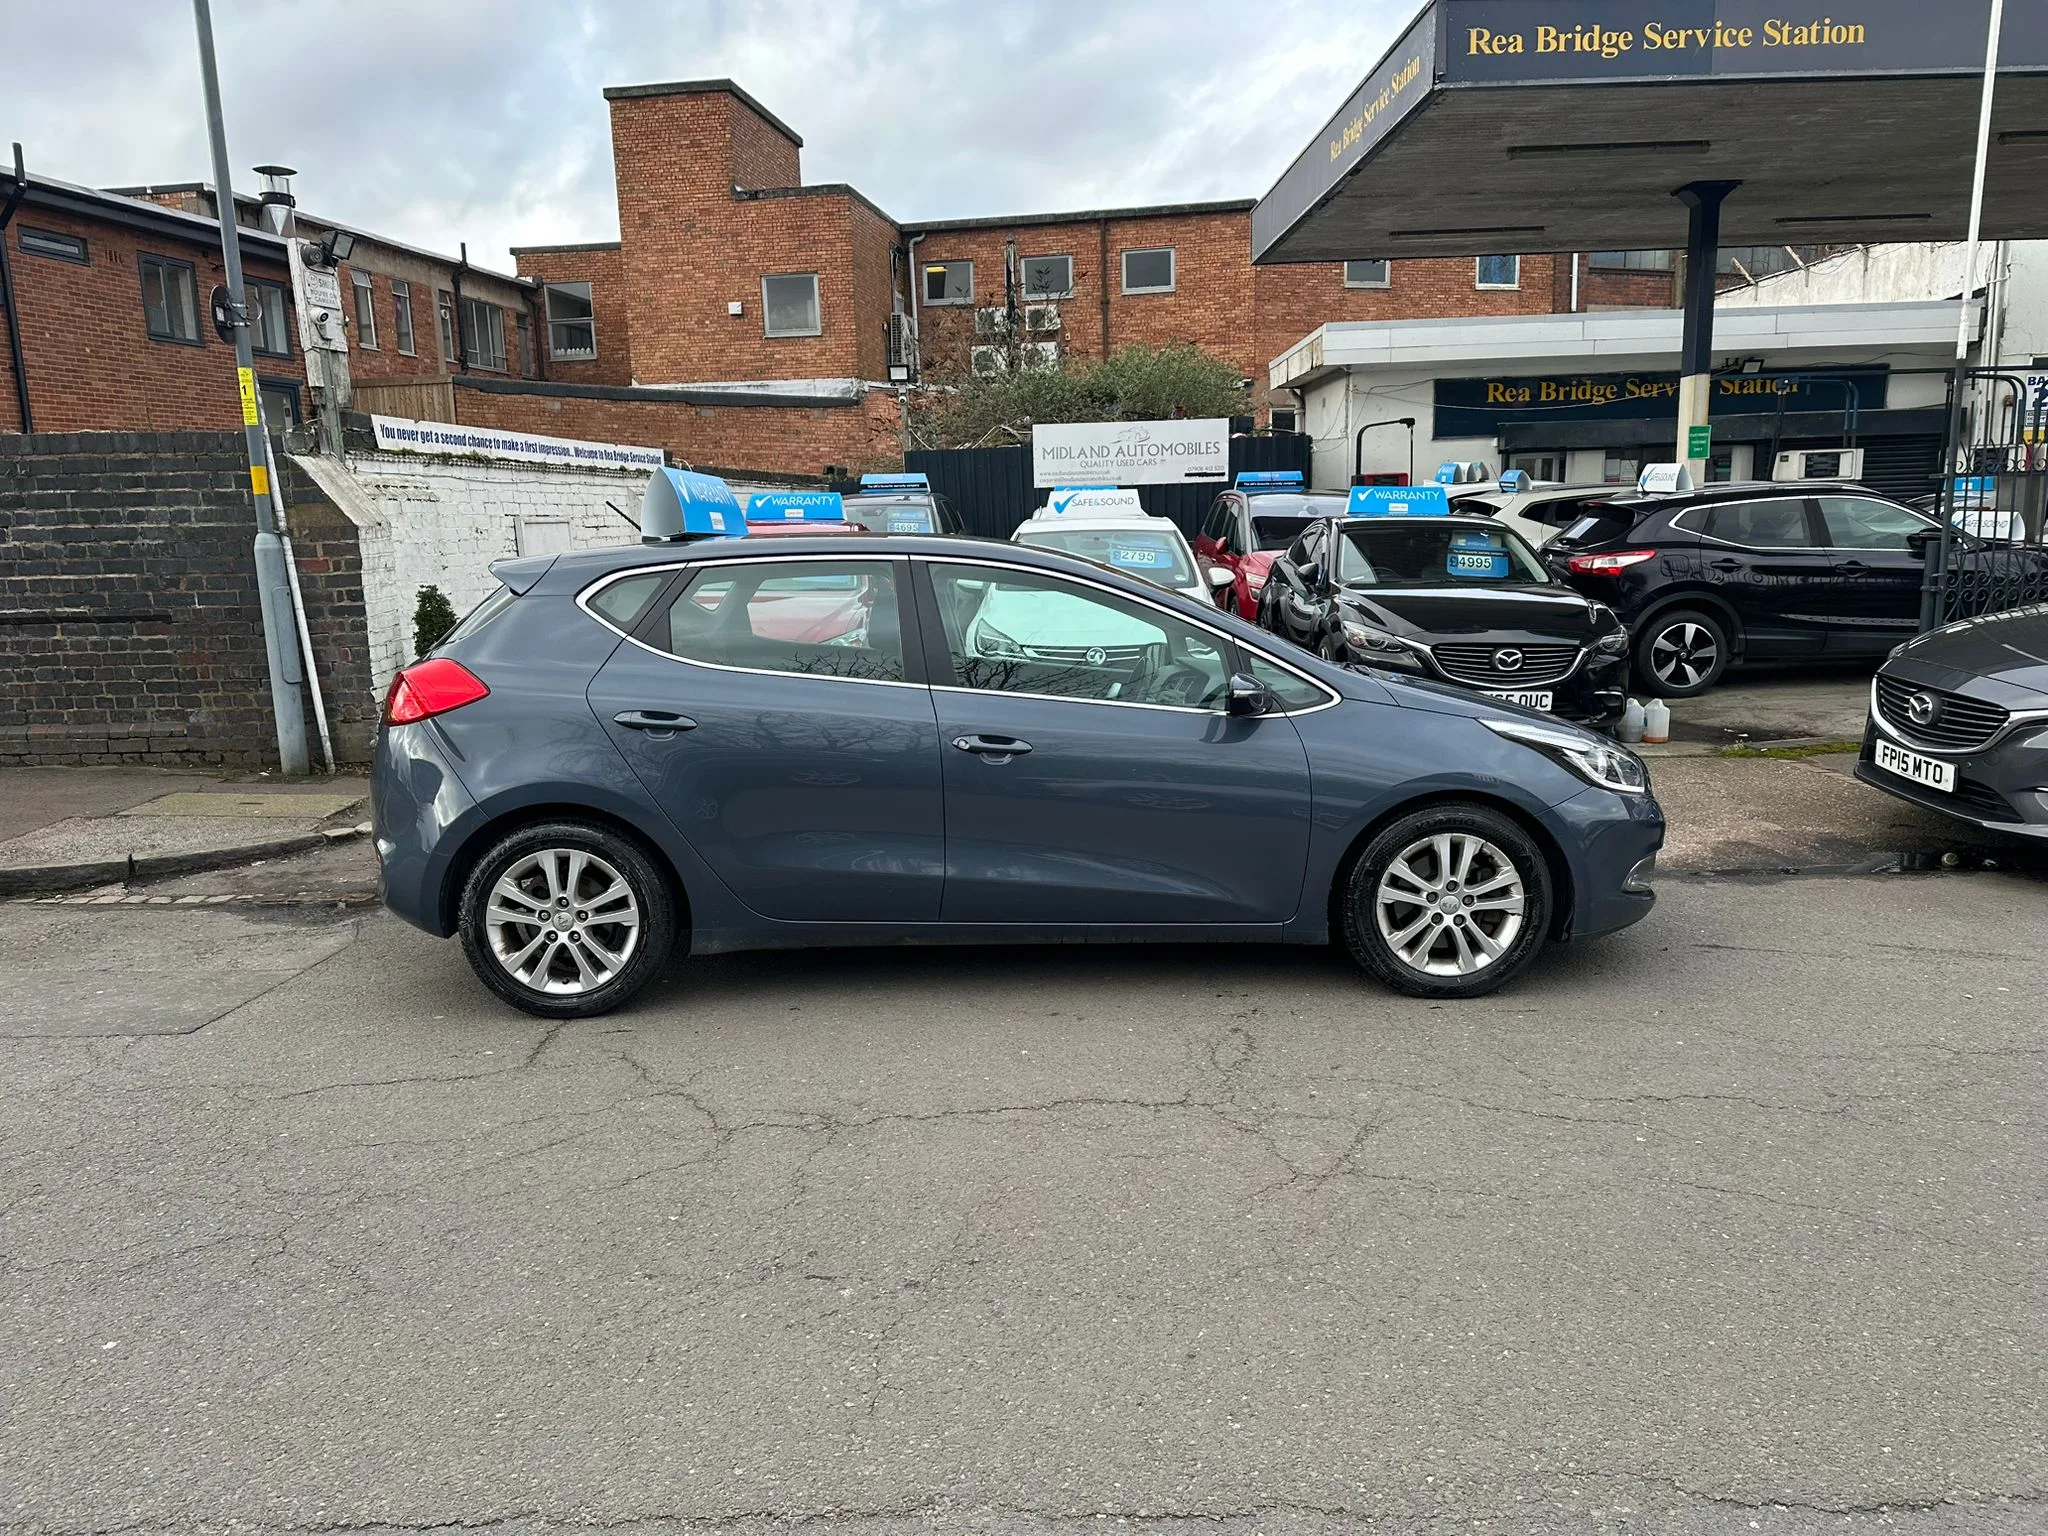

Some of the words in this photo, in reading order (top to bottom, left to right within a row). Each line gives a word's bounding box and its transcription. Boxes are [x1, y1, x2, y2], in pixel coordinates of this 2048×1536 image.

[1466, 27, 1524, 56] Rea
[1534, 24, 1634, 59] Bridge
[1642, 20, 1753, 51] Service
[1762, 16, 1865, 47] Station
[1330, 140, 1341, 162] Rea
[1343, 116, 1363, 150] Bridge
[1363, 87, 1390, 127] Service
[1391, 55, 1420, 99] Station
[241, 384, 247, 395] 1
[1486, 382, 1531, 403] Rea
[1539, 380, 1618, 405] Bridge
[1625, 378, 1678, 398] Serv
[380, 424, 396, 440] You
[397, 429, 419, 442] never
[420, 431, 433, 444] get
[434, 432, 440, 444] a
[440, 432, 467, 447] second
[467, 435, 492, 449] chance
[493, 437, 501, 450] to
[501, 439, 520, 452] make
[519, 441, 524, 452] a
[524, 440, 538, 454] first
[573, 446, 598, 460] Welcome
[598, 450, 604, 460] to
[604, 450, 613, 461] Rea
[613, 450, 629, 464] Bridge
[629, 452, 646, 464] Service
[646, 453, 662, 465] Station
[1042, 445, 1111, 460] MIDLAND
[1115, 441, 1221, 459] AUTOMOBILES
[1080, 459, 1115, 469] QUALITY
[1116, 459, 1135, 468] USED
[1136, 457, 1158, 467] CARS
[687, 478, 736, 506] WARRANTY
[1373, 490, 1440, 500] WARRANTY
[771, 496, 835, 506] WARRANTY
[1071, 496, 1135, 507] SAFE&SOUND
[1449, 556, 1491, 569] £4995
[1881, 745, 1909, 773] FP15
[1913, 756, 1943, 784] MTO
[1442, 902, 1458, 910] KIA
